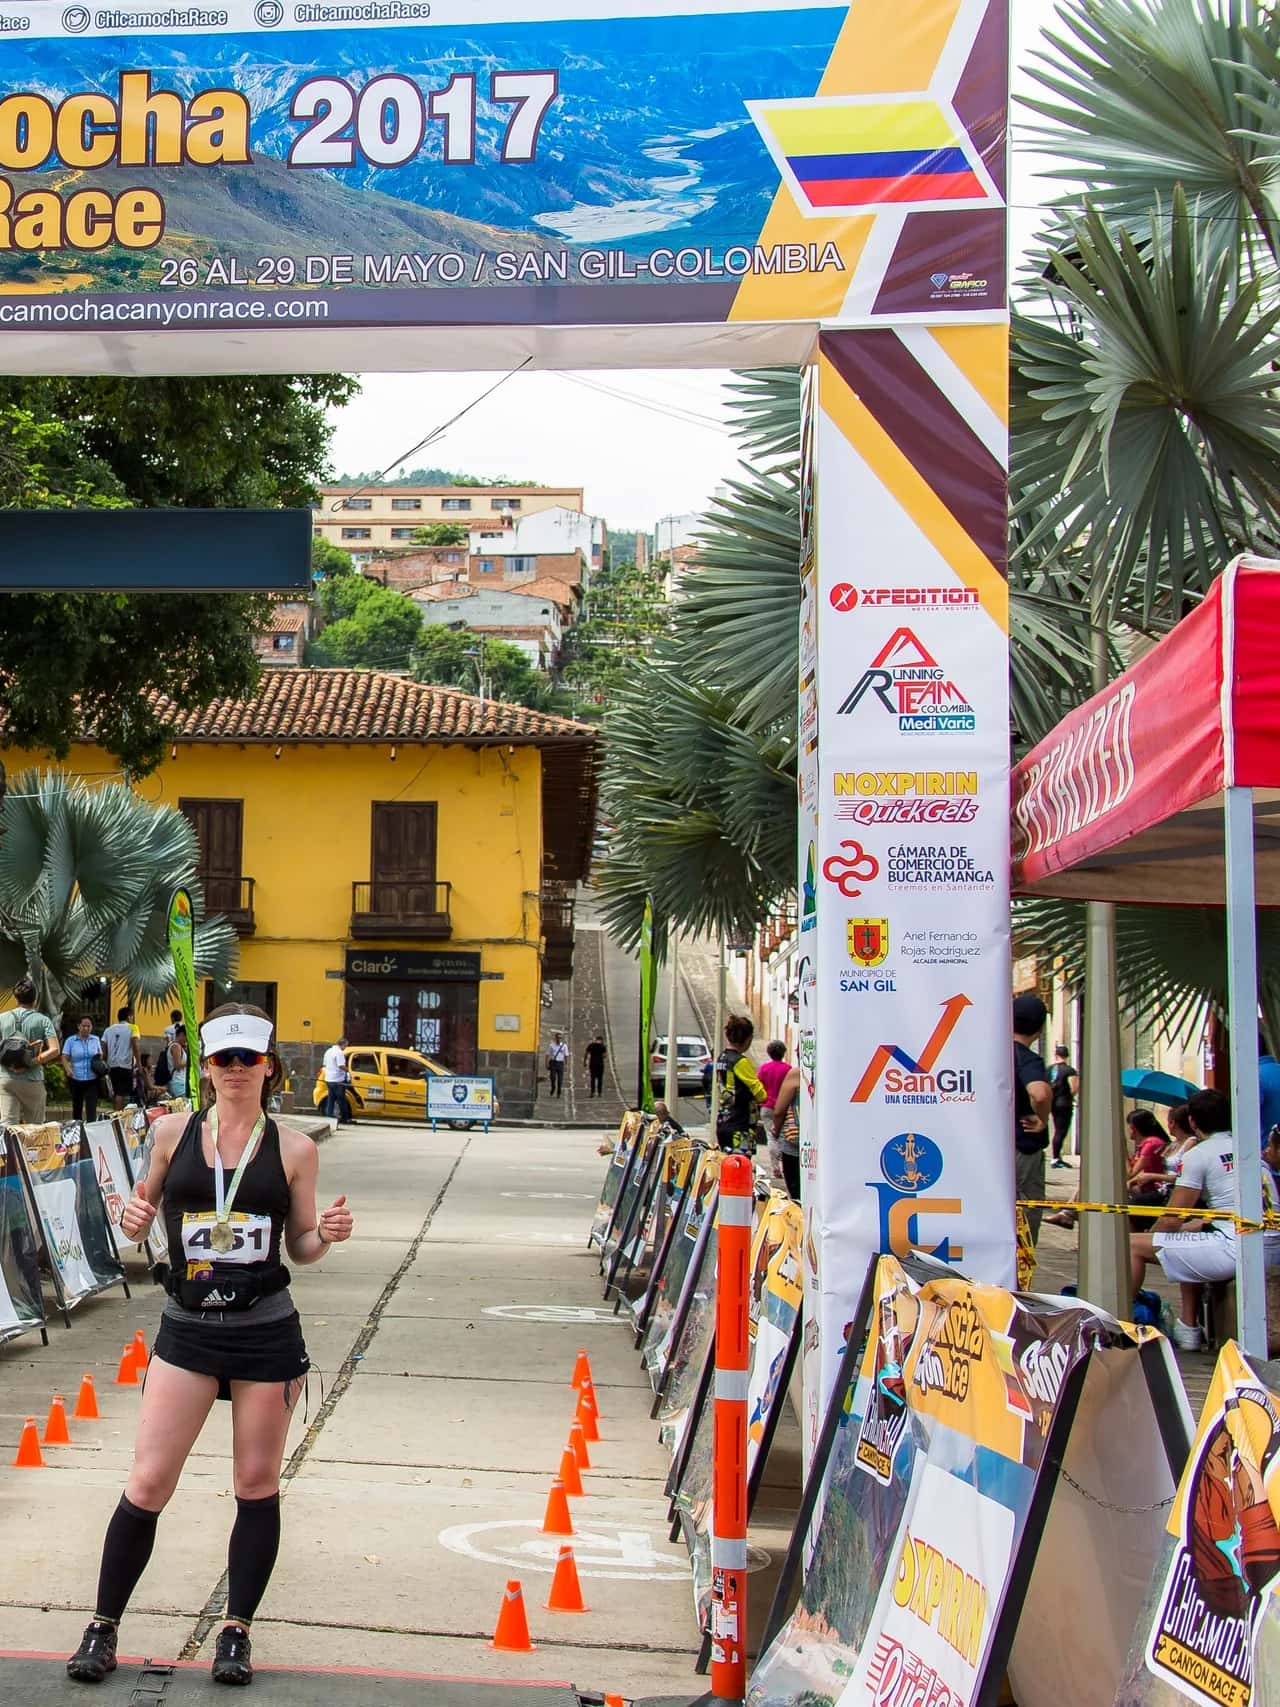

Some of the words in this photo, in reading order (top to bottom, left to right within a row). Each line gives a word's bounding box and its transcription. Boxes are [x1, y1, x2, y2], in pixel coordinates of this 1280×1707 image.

[94, 8, 227, 30] ChicamochaRace
[293, 1, 430, 23] ChicamochaRace
[287, 69, 560, 169] 2017
[160, 260, 196, 287] 26
[205, 258, 249, 286] AL
[255, 257, 296, 285] 29
[305, 257, 353, 283] DE
[362, 253, 465, 282] MAYO
[493, 252, 567, 281] SAN
[578, 240, 845, 280] GIL-COLOMBIA
[861, 588, 979, 604] XPEDITION
[894, 681, 968, 714] TEAM
[921, 705, 974, 713] COLOMBIA
[834, 772, 978, 796] NOXPIRIN
[853, 799, 979, 825] QuickGels
[888, 844, 946, 858] CÁMARA
[950, 847, 967, 858] DE
[888, 859, 954, 870] COMERCIO
[958, 859, 974, 870] DE
[888, 871, 994, 882] BUCARAMANGA
[946, 883, 994, 891] Santander
[904, 931, 926, 941] Ariel
[929, 931, 977, 941] Fernando
[901, 946, 926, 957] Rojas
[352, 961, 391, 974] Claro
[840, 970, 883, 978] MUNICIPIO
[886, 970, 896, 978] DE
[840, 980, 869, 992] SAN
[874, 980, 897, 992] GIL
[885, 1069, 972, 1093] SanGil
[885, 1095, 900, 1104] UNA
[903, 1095, 938, 1104] GERENCIA
[940, 1091, 976, 1104] Social
[188, 1227, 262, 1250] 451
[892, 1528, 987, 1669] OXPIRIN
[1169, 1647, 1209, 1683] CANYON
[1209, 1675, 1237, 1702] RACE
